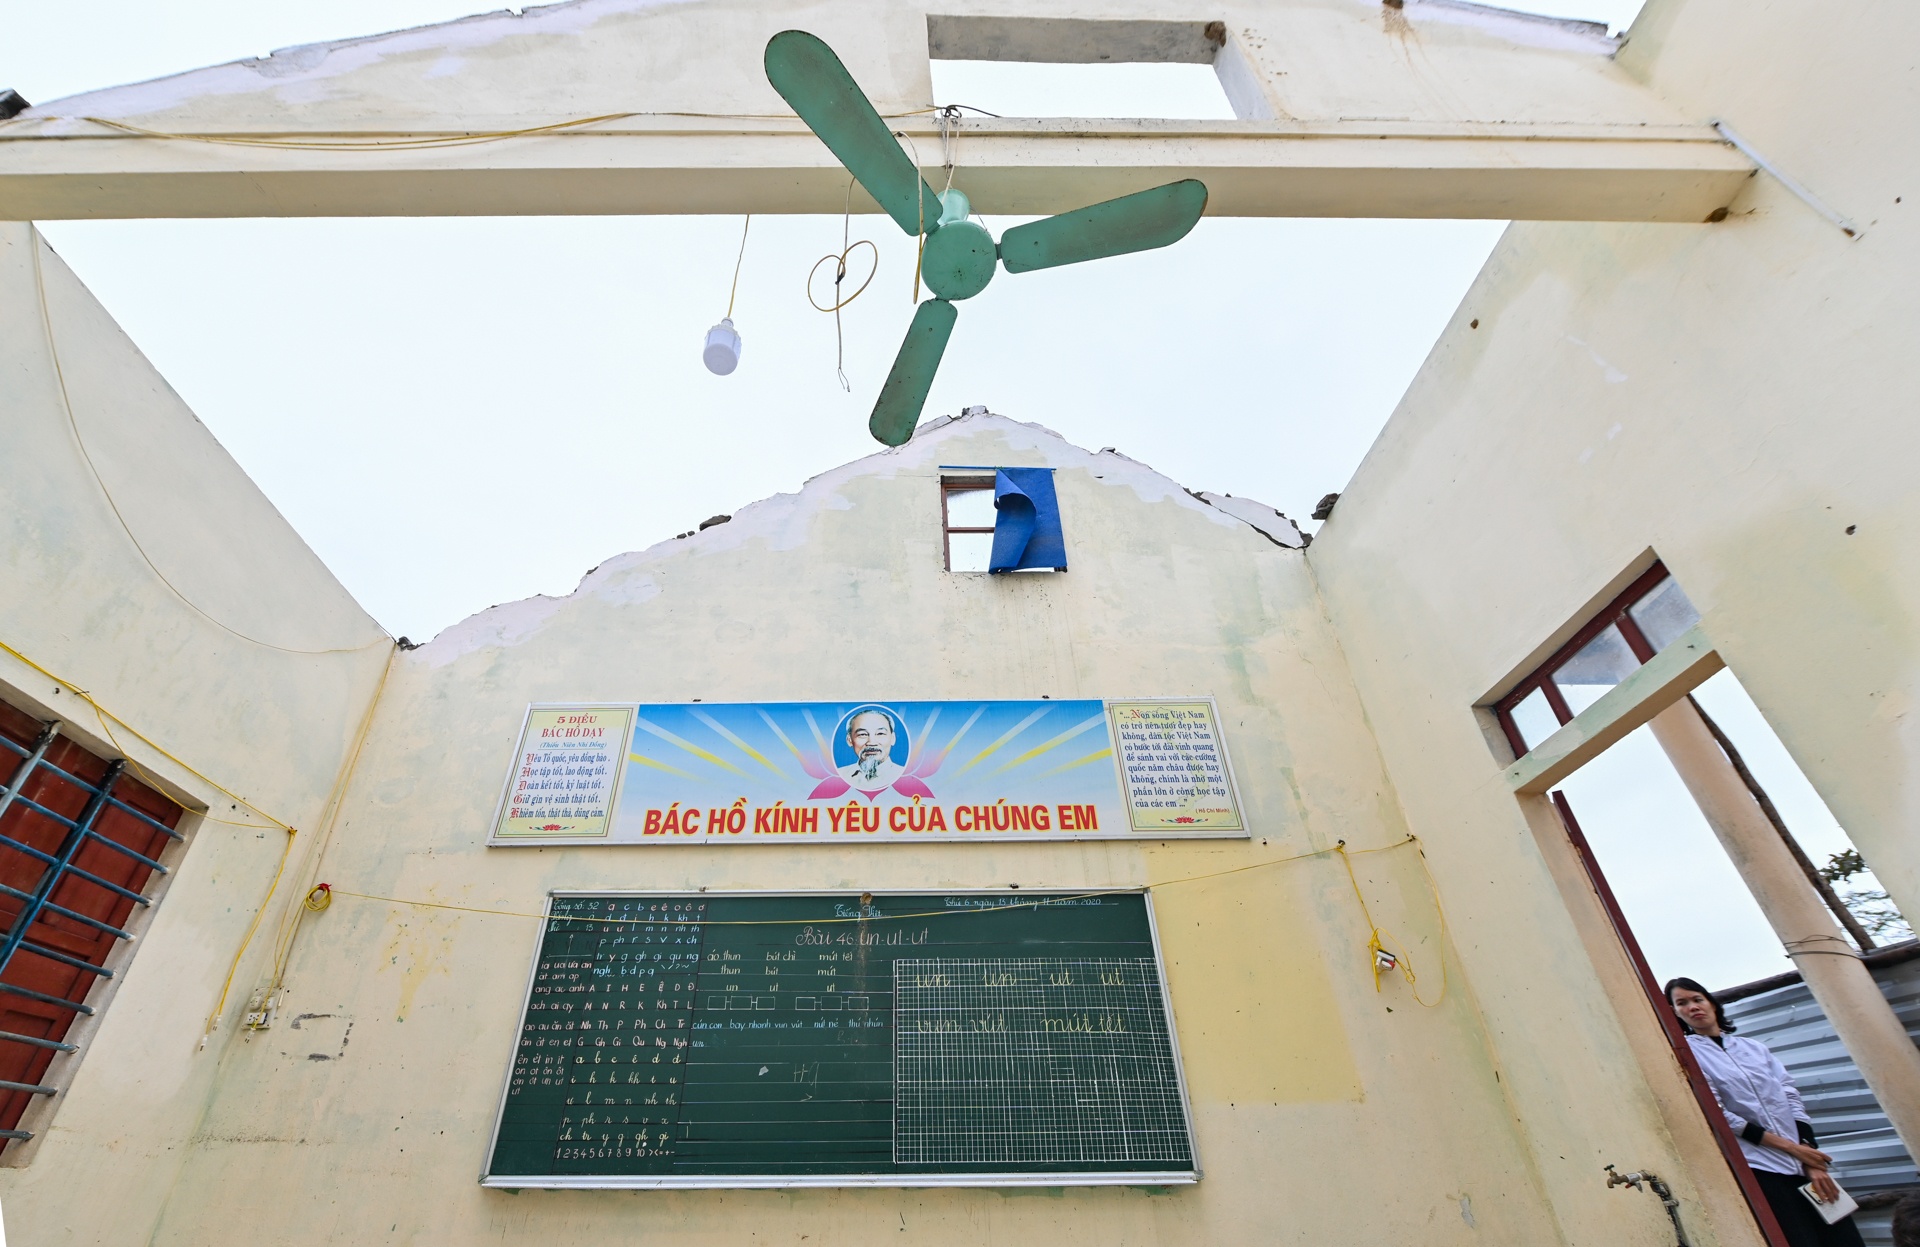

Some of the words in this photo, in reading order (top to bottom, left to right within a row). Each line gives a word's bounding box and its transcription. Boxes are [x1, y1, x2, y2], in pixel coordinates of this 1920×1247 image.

[557, 716, 565, 724] 5
[568, 713, 598, 726] ĐIỀU
[1152, 711, 1169, 720] sông
[1170, 710, 1187, 720] Việt
[1188, 710, 1205, 719] Nam
[1120, 721, 1130, 730] có
[1145, 721, 1159, 730] nên
[1178, 720, 1192, 731] đẹp
[1194, 721, 1208, 731] hay
[541, 726, 564, 738] BÁC
[565, 726, 580, 738] HỒ
[582, 728, 605, 739] DẠY
[1122, 732, 1148, 742] không,
[1148, 732, 1164, 740] dân
[1165, 732, 1176, 741] tộc
[1176, 732, 1192, 741] Việt
[1193, 732, 1211, 740] Nam
[1124, 743, 1133, 751] có
[1133, 742, 1151, 751] bước
[1175, 742, 1191, 751] vinh
[1192, 744, 1214, 752] quang
[580, 752, 595, 764] đồng
[1137, 753, 1154, 761] sánh
[1155, 753, 1167, 761] vai
[1181, 753, 1194, 761] các
[539, 766, 551, 778] tập
[565, 766, 575, 776] lao
[576, 766, 594, 777] động
[1128, 763, 1146, 773] quốc
[1166, 763, 1185, 772] châu
[1205, 763, 1220, 773] hay
[540, 779, 552, 789] kết
[576, 780, 590, 791] luật
[1130, 774, 1157, 785] không,
[1158, 774, 1180, 783] chính
[1181, 774, 1190, 783] là
[1207, 775, 1223, 784] một
[1176, 787, 1195, 797] công
[1196, 786, 1211, 797] học
[1212, 786, 1226, 798] tập
[555, 793, 570, 804] sinh
[571, 793, 586, 805] thật
[1150, 798, 1164, 808] các
[1165, 800, 1177, 808] em
[548, 807, 561, 819] thật
[642, 801, 701, 836] BÁC
[706, 797, 748, 835] HỒ
[753, 801, 819, 835] KÍNH
[826, 800, 880, 834] YÊU
[888, 794, 948, 832] CỦA
[954, 798, 1051, 832] CHÚNG
[1056, 804, 1099, 831] EM
[964, 898, 970, 906] 6
[1080, 898, 1101, 906] 2020
[795, 926, 833, 945] Bài
[707, 949, 720, 961] áo
[722, 950, 741, 961] thun
[766, 951, 780, 961] bút
[782, 950, 796, 961] chì
[720, 964, 741, 975] thun
[765, 966, 779, 975] bút
[769, 982, 779, 991] ut
[708, 1021, 723, 1029] con
[729, 1018, 746, 1031] bay
[774, 1021, 788, 1029] vun
[791, 1018, 803, 1029] vút
[556, 1149, 561, 1158] 1
[563, 1148, 570, 1158] 2
[573, 1149, 579, 1158] 3
[580, 1149, 587, 1158] 4
[589, 1148, 595, 1158] 5
[599, 1149, 604, 1158] 6
[608, 1149, 613, 1158] 7
[617, 1149, 622, 1157] 8
[625, 1148, 631, 1157] 9
[636, 1148, 645, 1158] 10
